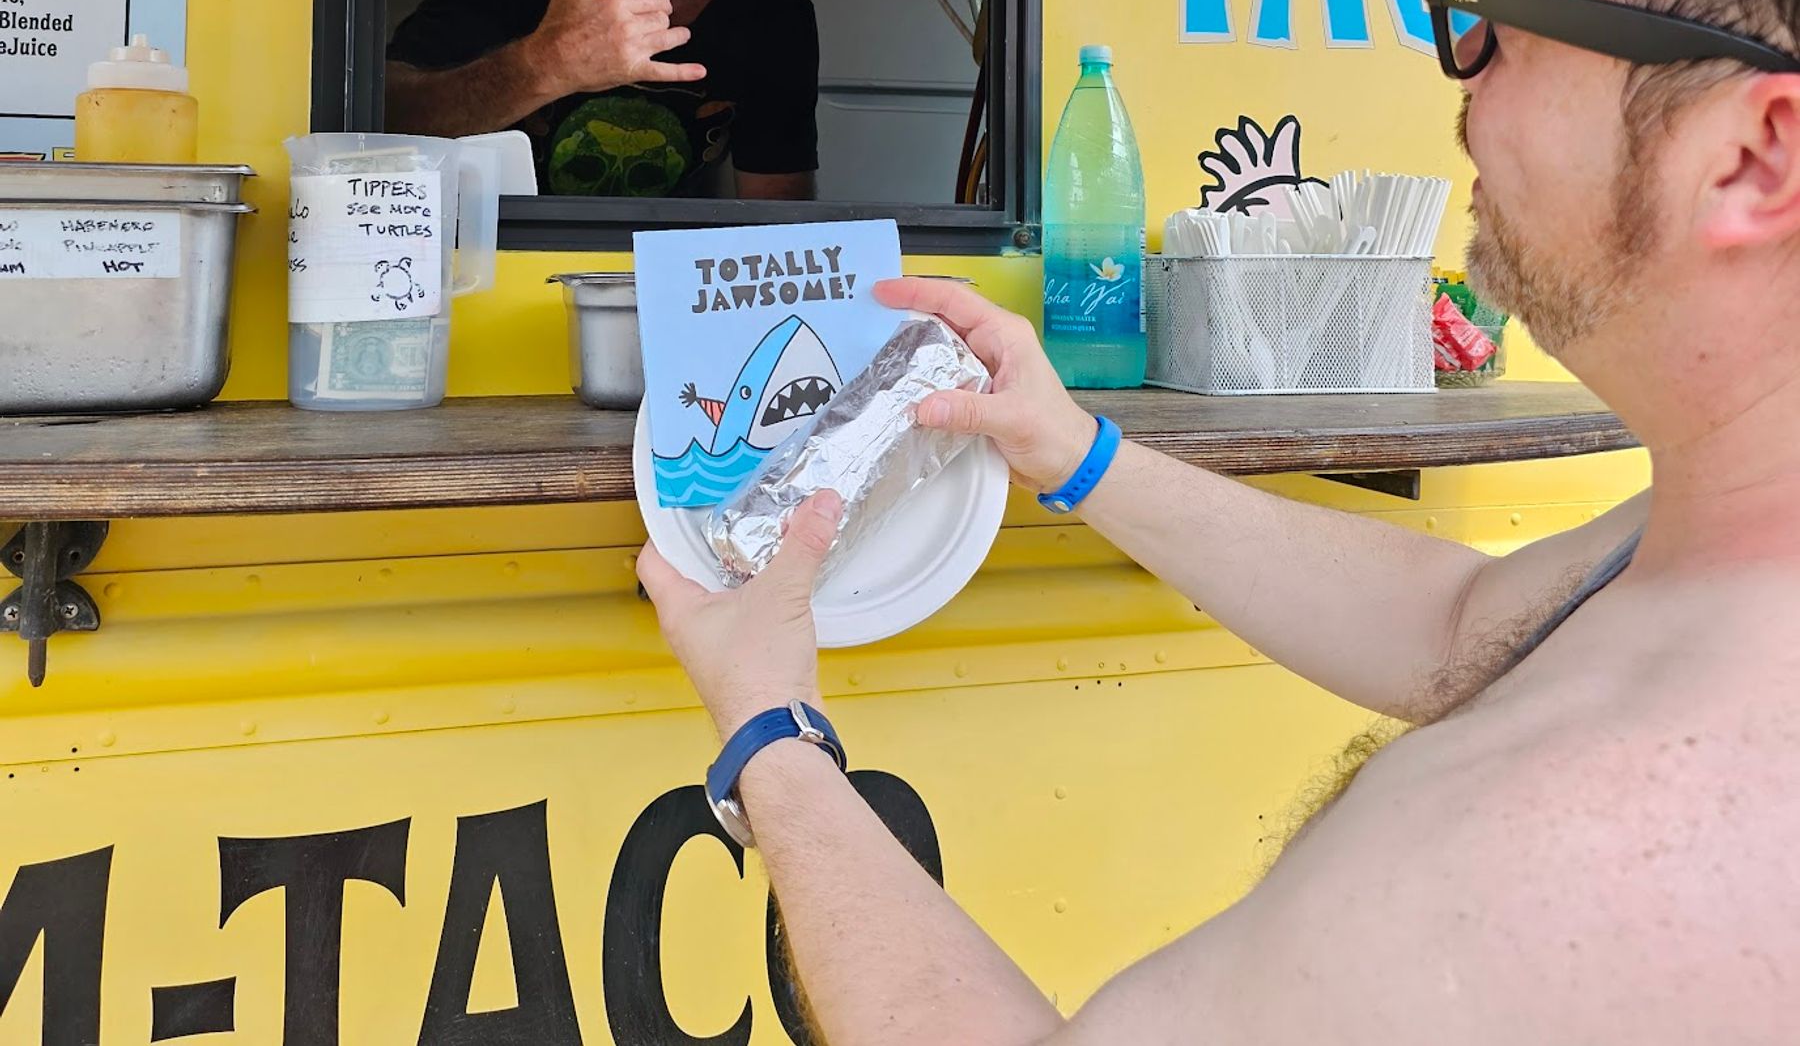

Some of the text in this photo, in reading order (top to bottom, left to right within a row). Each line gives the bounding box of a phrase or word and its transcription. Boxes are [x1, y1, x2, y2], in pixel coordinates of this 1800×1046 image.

[0, 11, 73, 33] Blended
[347, 178, 428, 200] TIPPERS
[358, 223, 434, 238] TURTLES
[102, 260, 145, 273] HOT
[694, 245, 843, 285] TOTALLY
[691, 273, 857, 314] JAWSOME!
